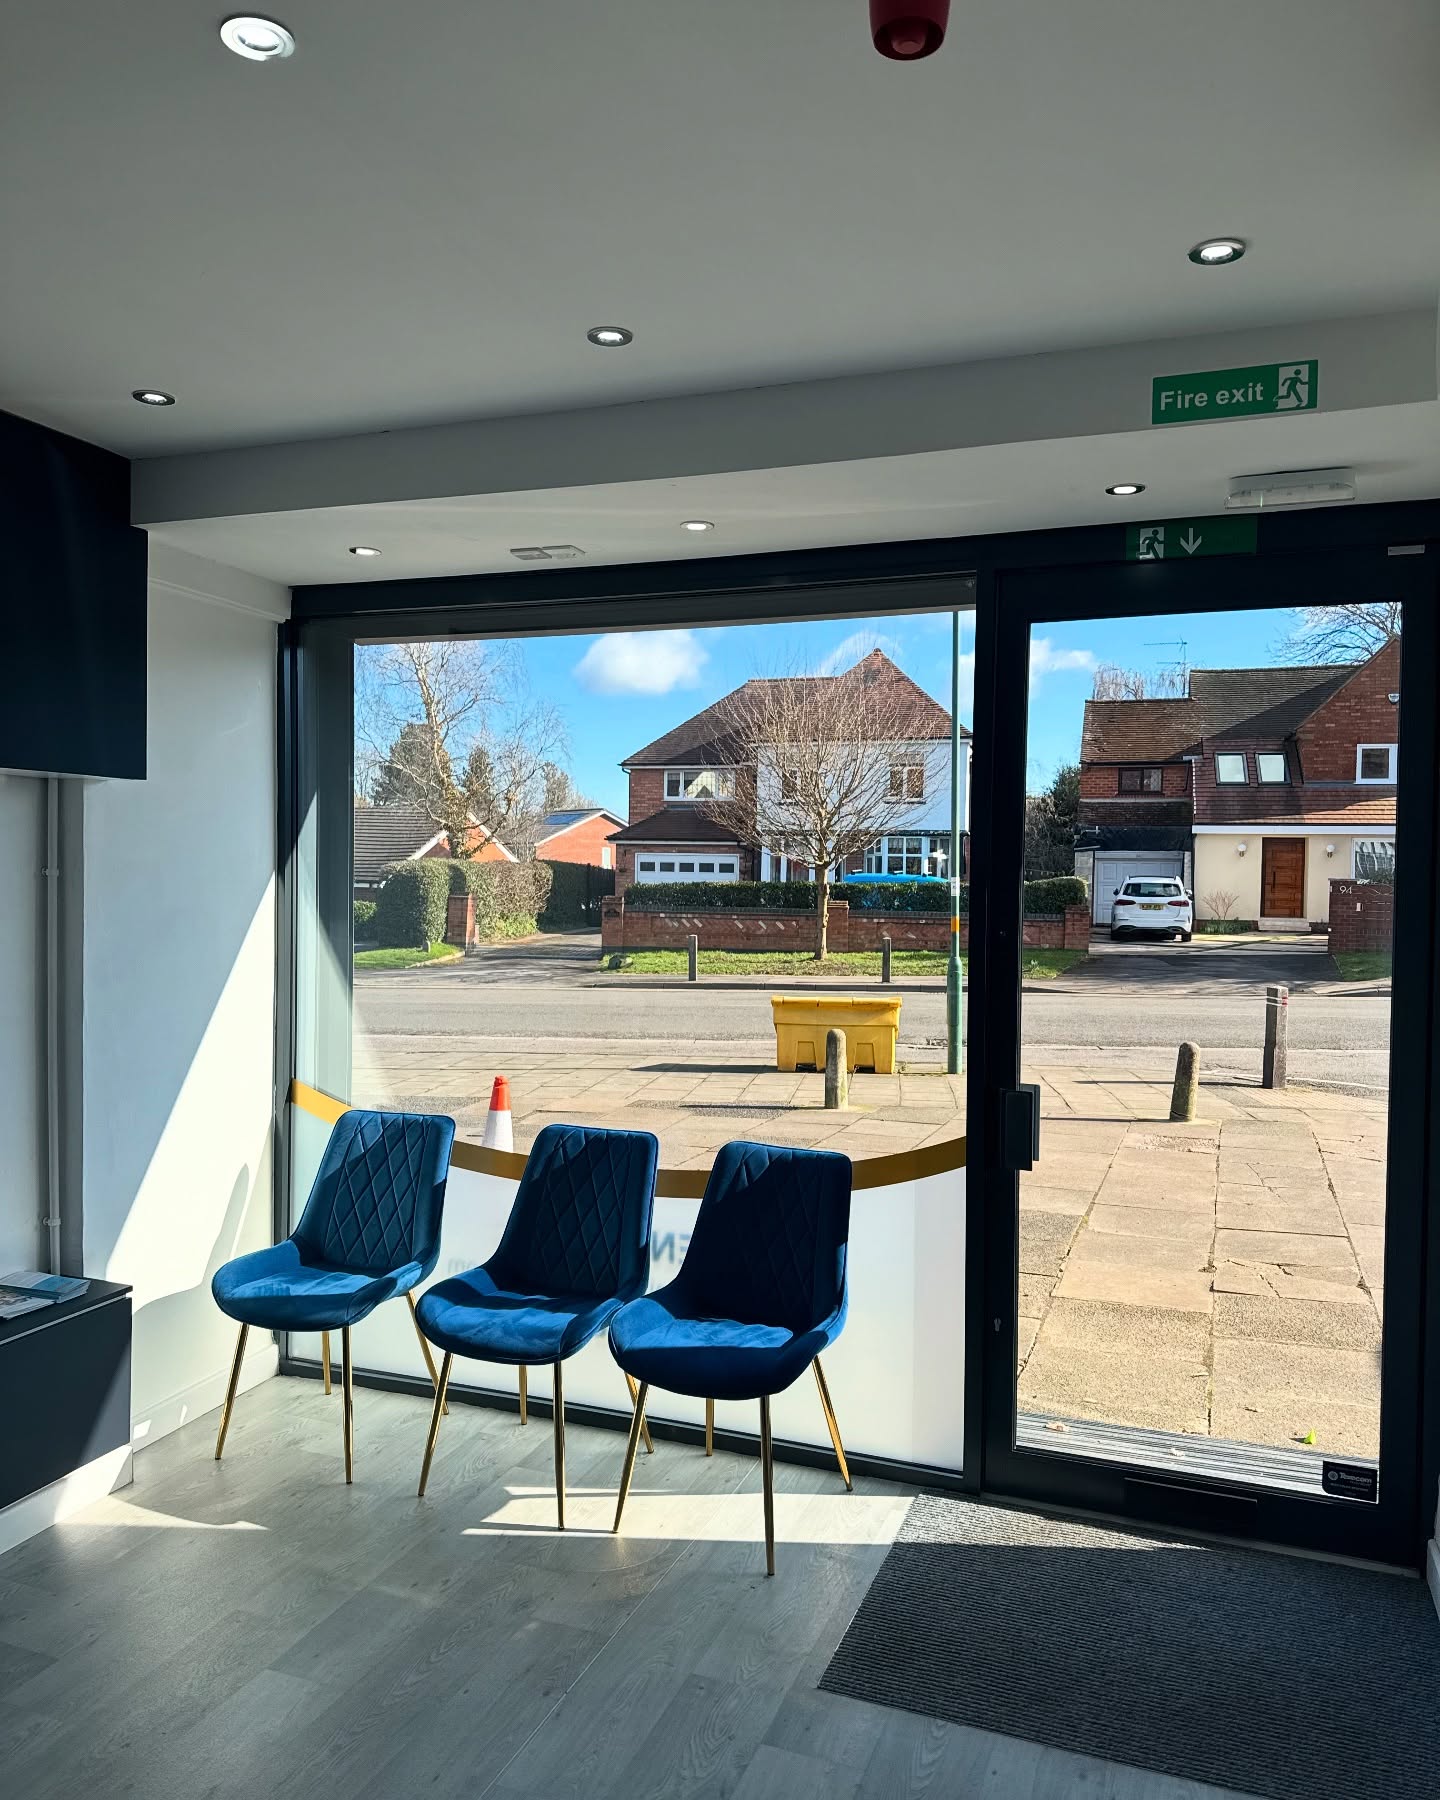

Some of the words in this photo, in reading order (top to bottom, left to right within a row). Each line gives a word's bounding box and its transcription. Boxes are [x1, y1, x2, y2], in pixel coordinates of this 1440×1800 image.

[1160, 389, 1208, 411] Fire
[1215, 382, 1264, 405] exit
[1339, 885, 1353, 895] 94
